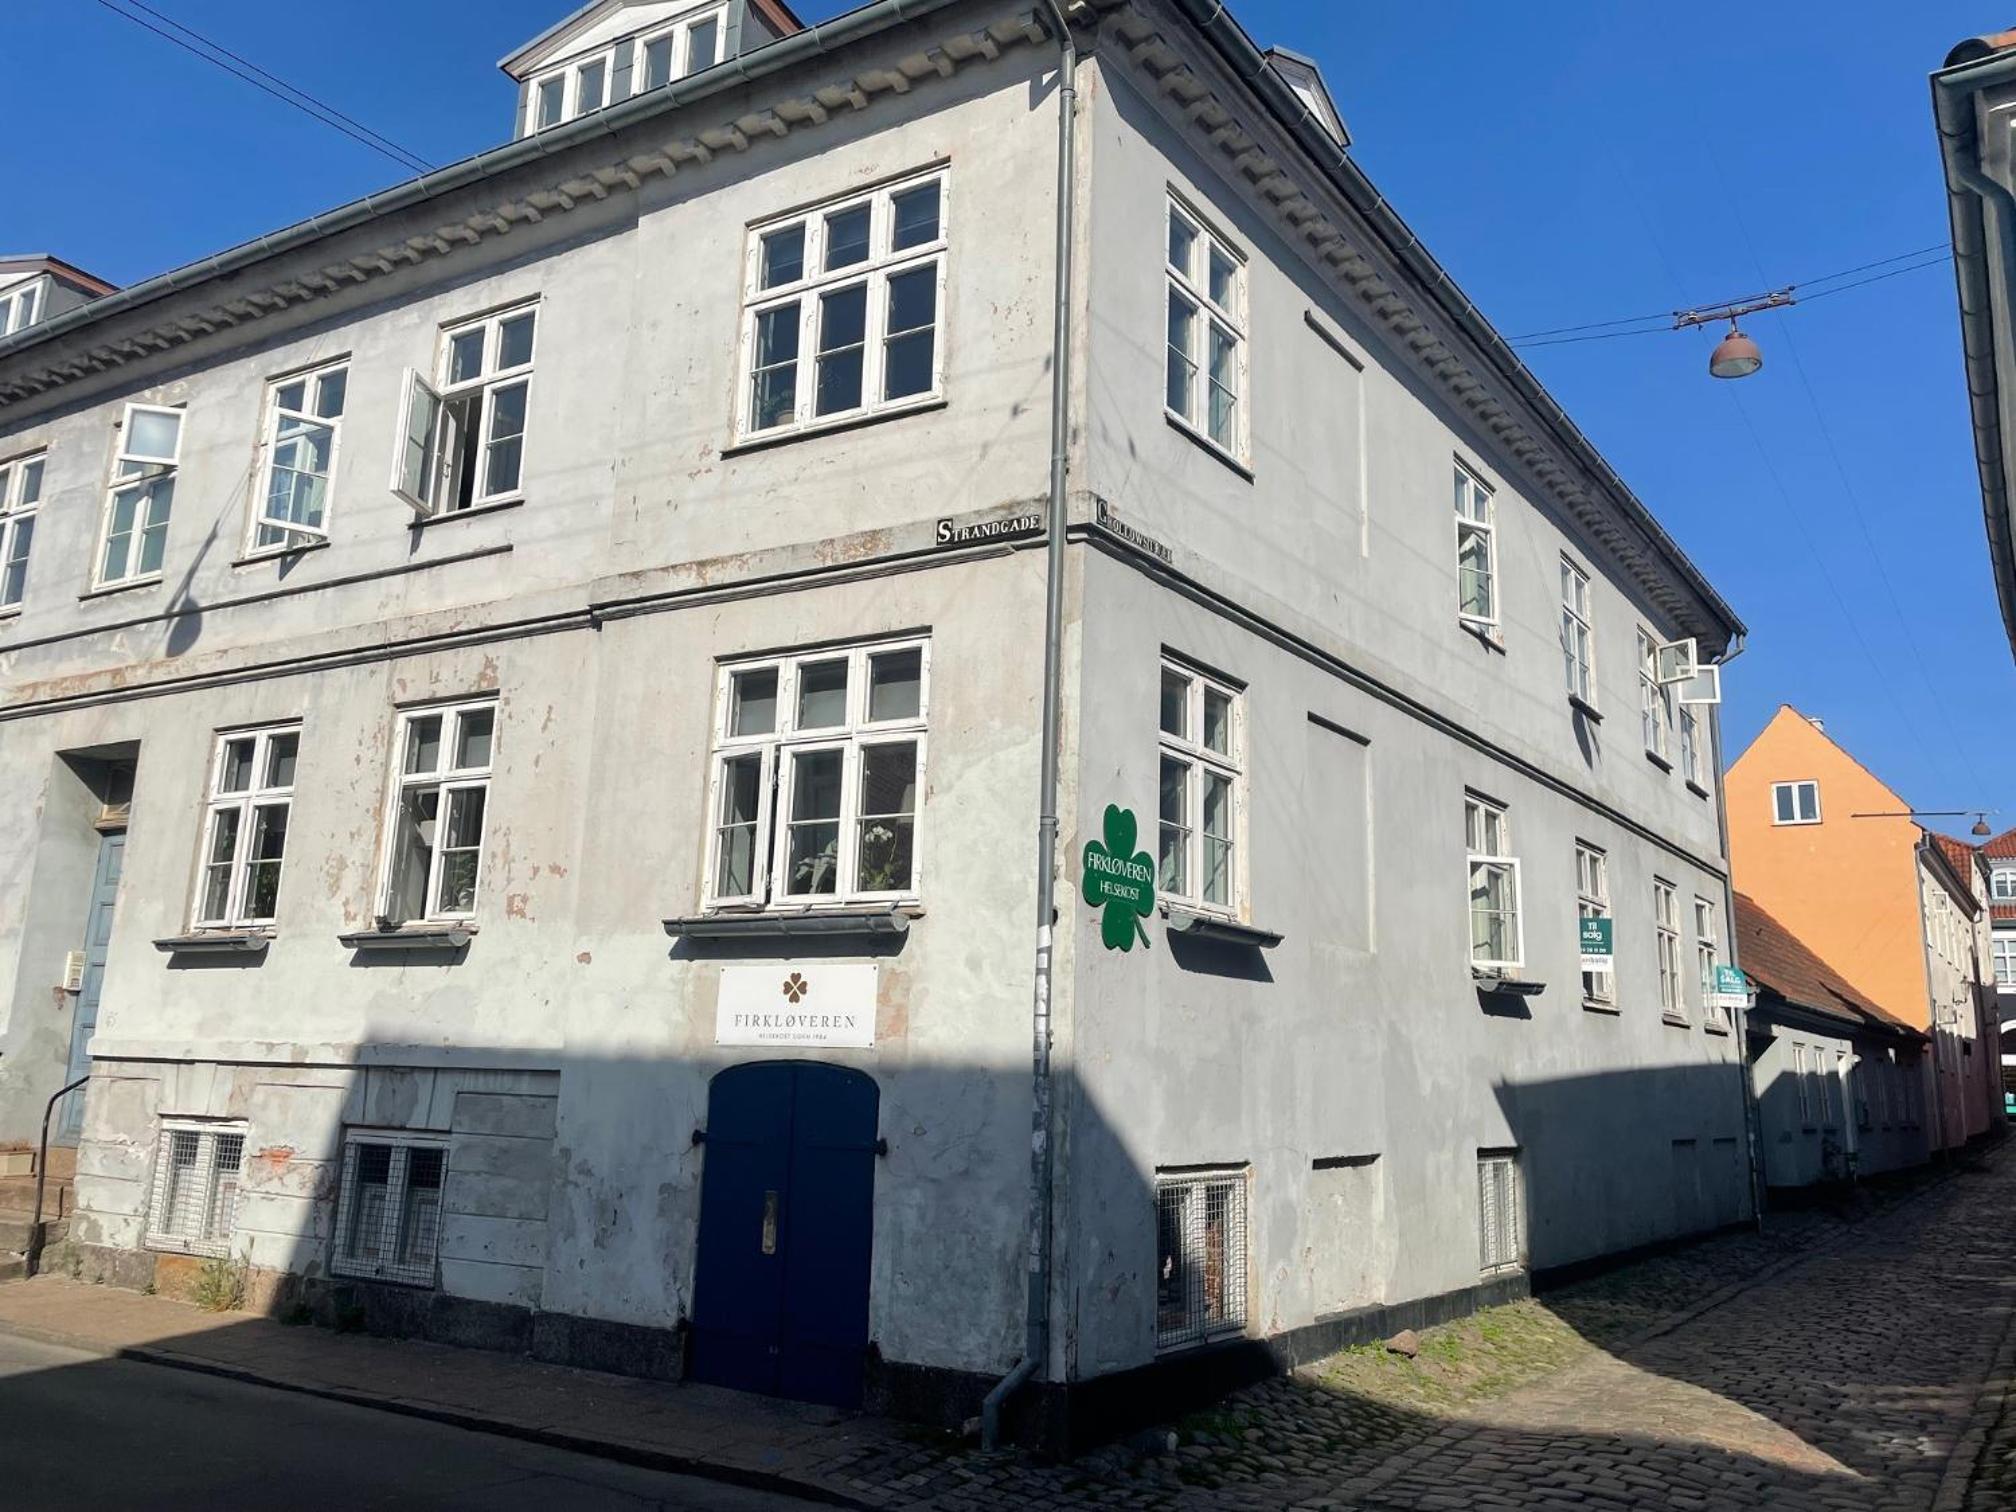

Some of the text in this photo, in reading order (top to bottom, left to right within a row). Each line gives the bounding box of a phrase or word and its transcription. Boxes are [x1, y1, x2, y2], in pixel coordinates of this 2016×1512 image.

[937, 515, 1040, 543] STRANDGADE
[1087, 851, 1152, 884] FIRKLØVEREN
[1100, 879, 1140, 900] HELSEKOST
[1587, 921, 1598, 930] Til
[734, 1014, 856, 1029] FIRKLØVEREN
